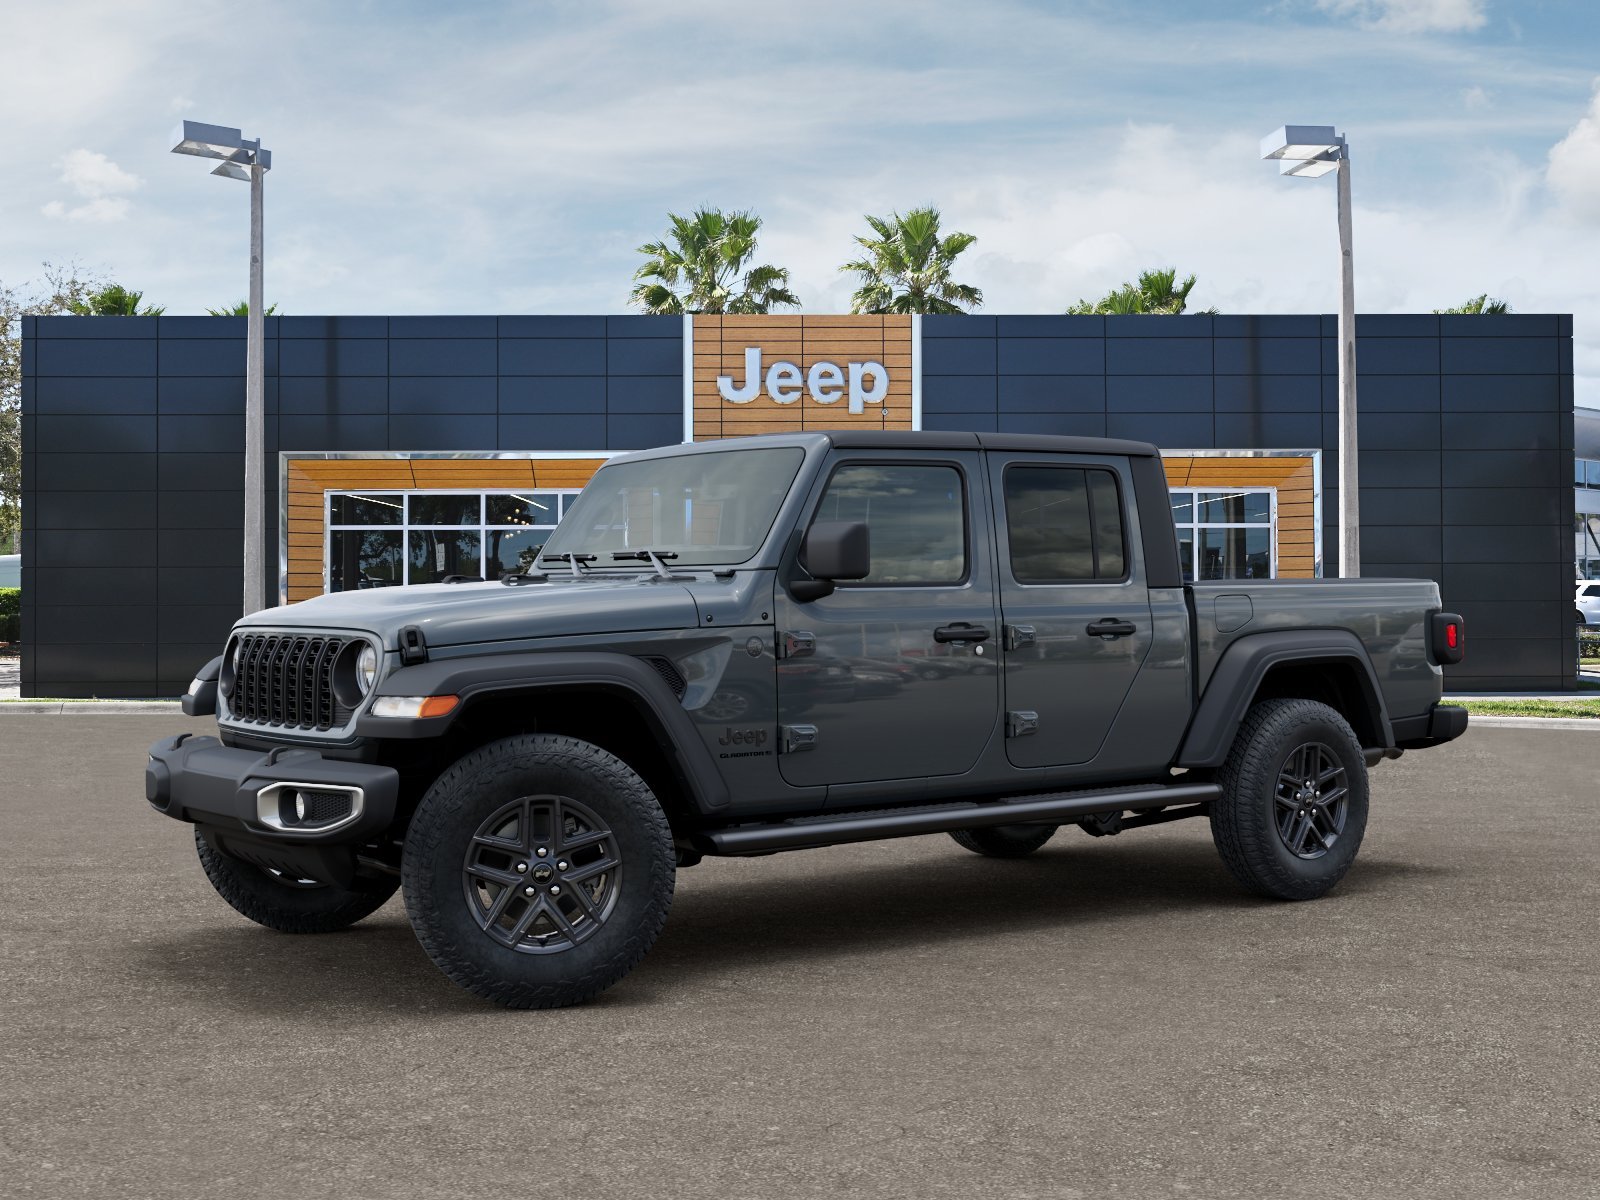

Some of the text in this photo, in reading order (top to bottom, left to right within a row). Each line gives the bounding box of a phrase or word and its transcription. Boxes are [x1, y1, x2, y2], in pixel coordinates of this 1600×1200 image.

[716, 347, 890, 415] Jeep
[719, 727, 768, 748] Jeep
[719, 750, 765, 759] GLADIATOR
